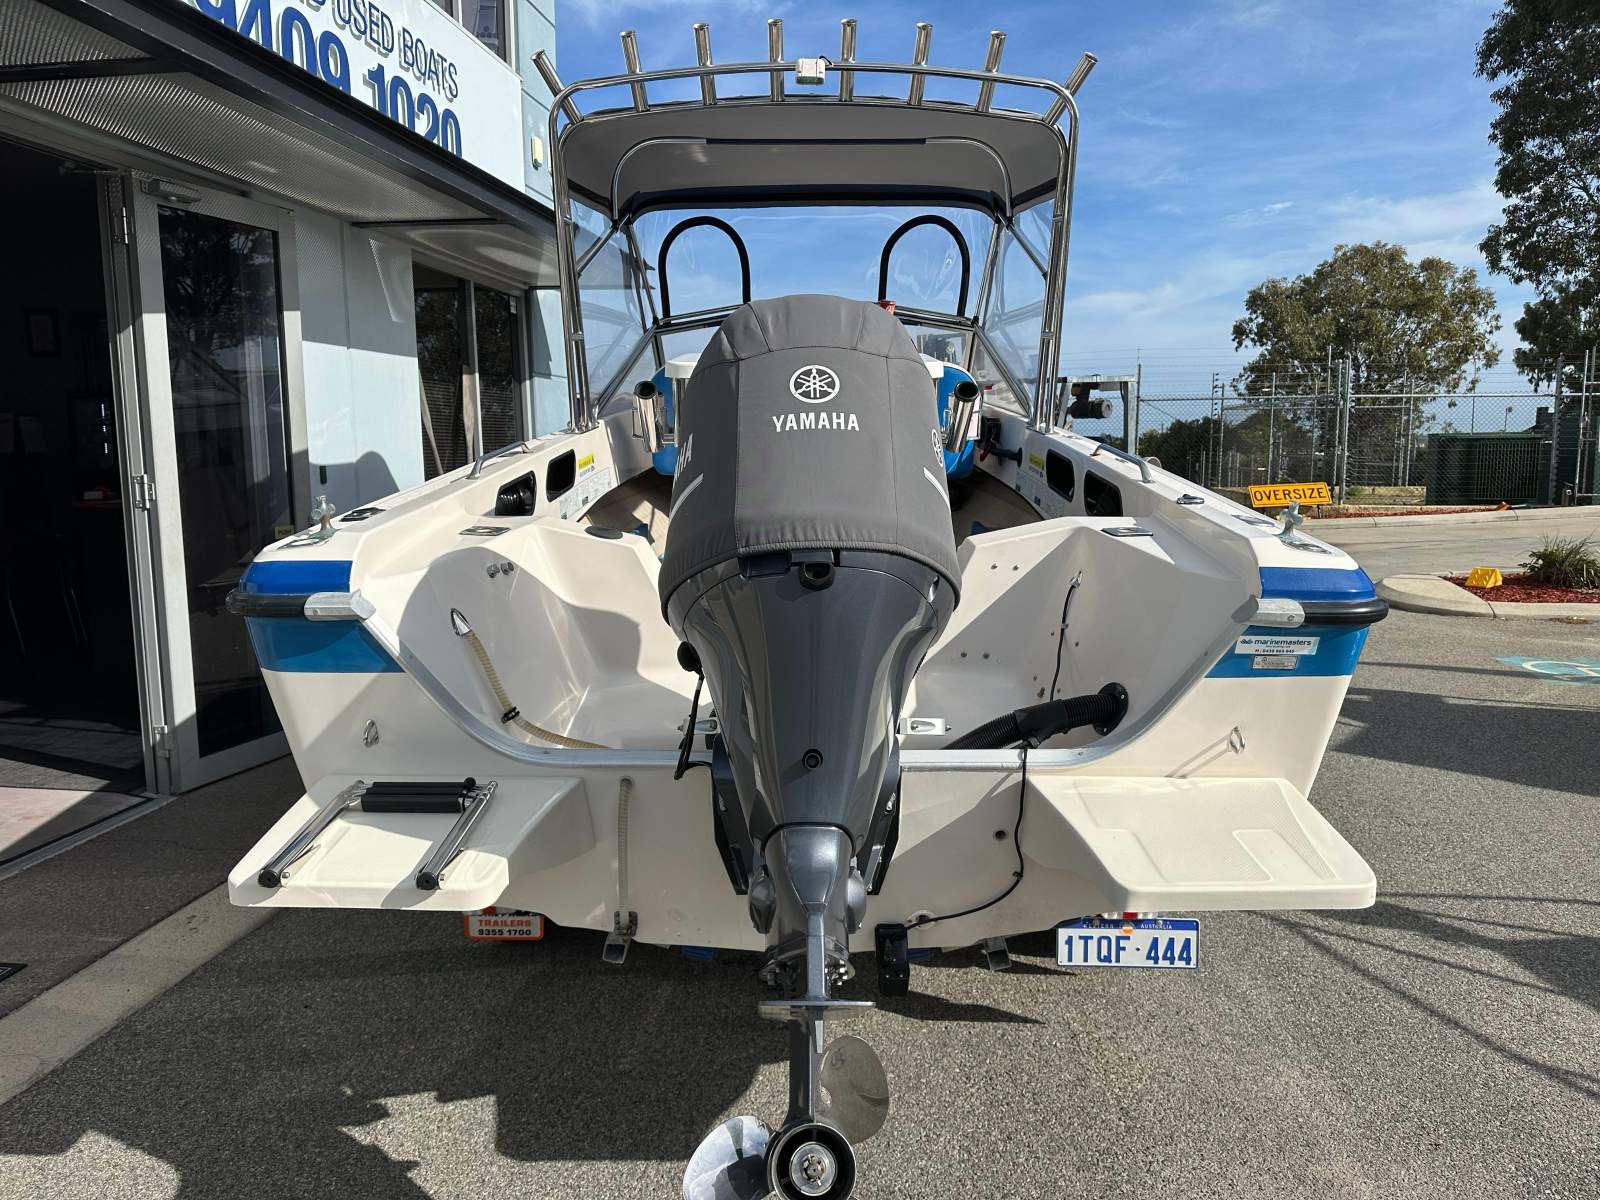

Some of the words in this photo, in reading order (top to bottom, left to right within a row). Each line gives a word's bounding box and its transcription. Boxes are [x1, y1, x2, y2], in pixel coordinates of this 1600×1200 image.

[335, 0, 394, 53] USED
[401, 27, 459, 99] BOATS
[367, 62, 462, 158] 1020
[772, 412, 860, 432] YAMAHA
[1253, 487, 1327, 501] OVERSIZE
[1254, 638, 1312, 646] marinemasters
[478, 919, 532, 927] TRAILERS
[478, 928, 504, 936] 9355
[507, 928, 532, 936] 1700
[1065, 935, 1130, 963] 1TQF
[1145, 936, 1192, 965] 444
